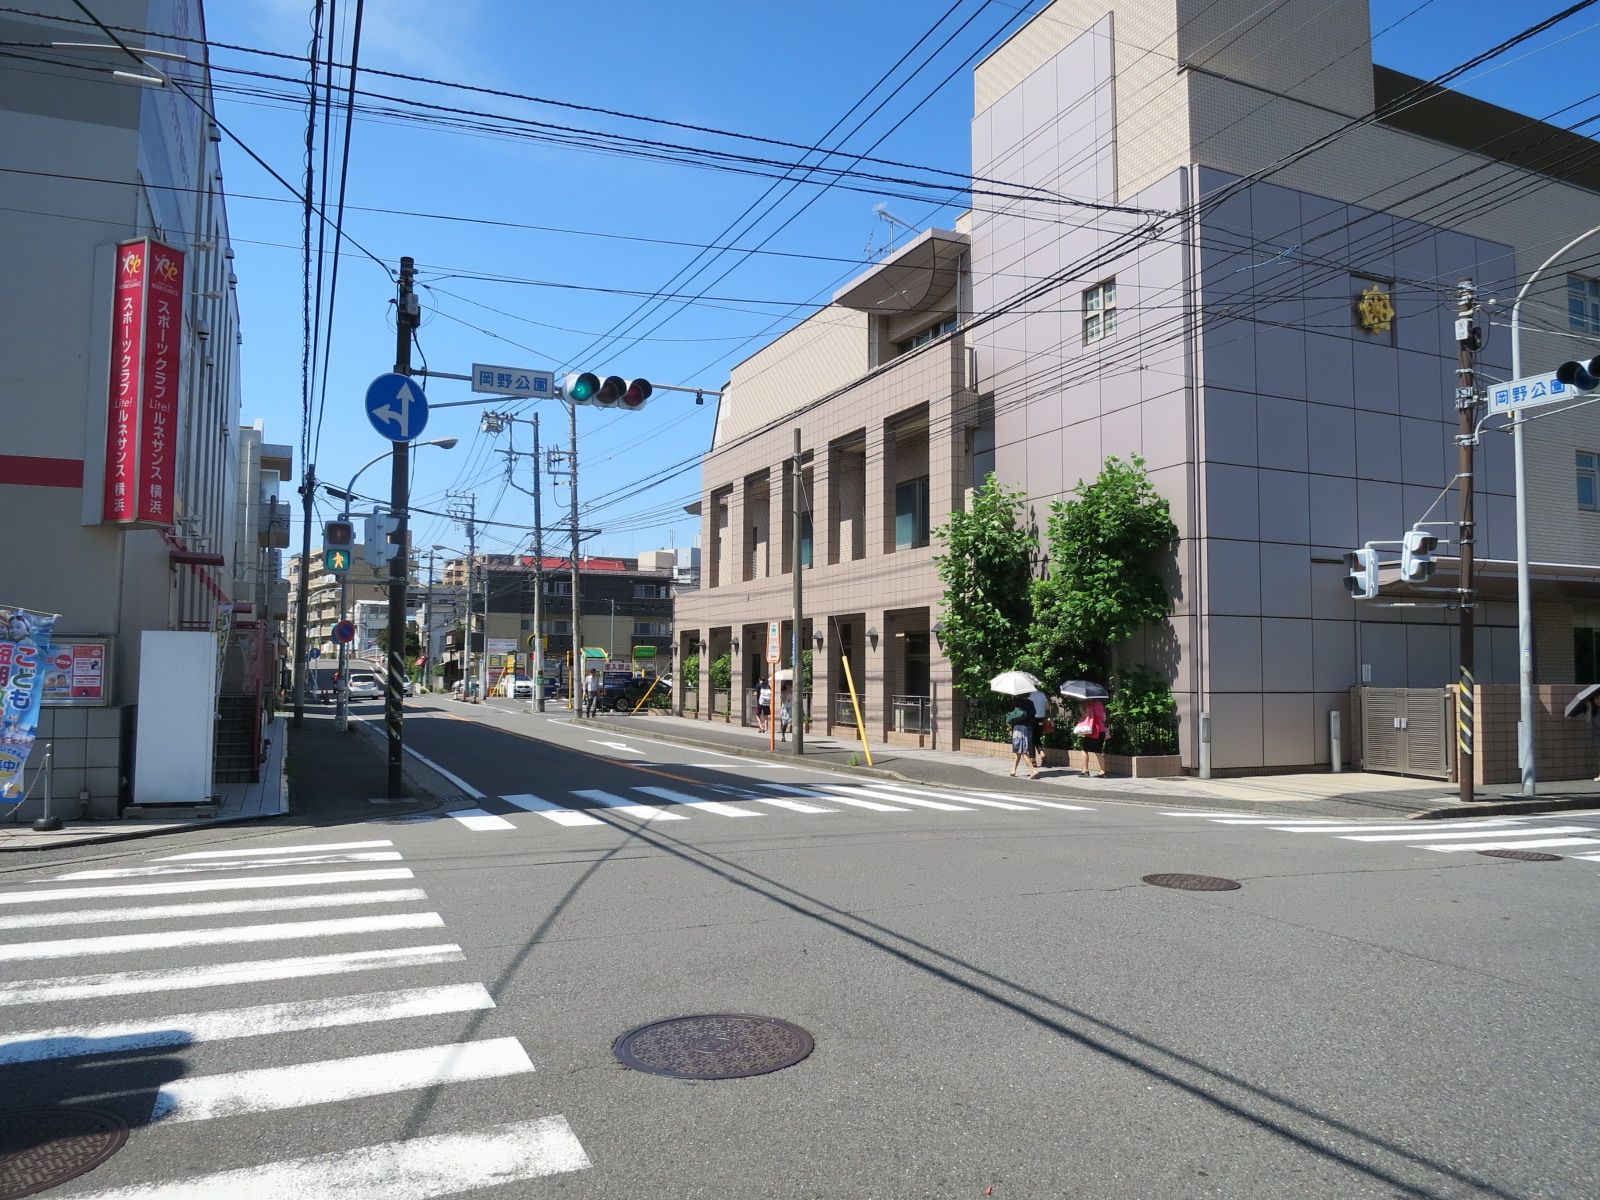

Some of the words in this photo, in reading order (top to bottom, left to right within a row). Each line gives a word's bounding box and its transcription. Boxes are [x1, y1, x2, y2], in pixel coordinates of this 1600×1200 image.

[119, 297, 133, 396] スポーツクラブ
[153, 299, 170, 399] スポーツクラブ
[479, 371, 549, 392] 岡野公園
[1495, 378, 1566, 406] 岡野公園
[115, 409, 129, 478] ルネサンス
[150, 412, 166, 480] ルネサンス
[114, 482, 126, 513] 横浜
[149, 483, 163, 515] 横浜
[9, 647, 38, 710] こども
